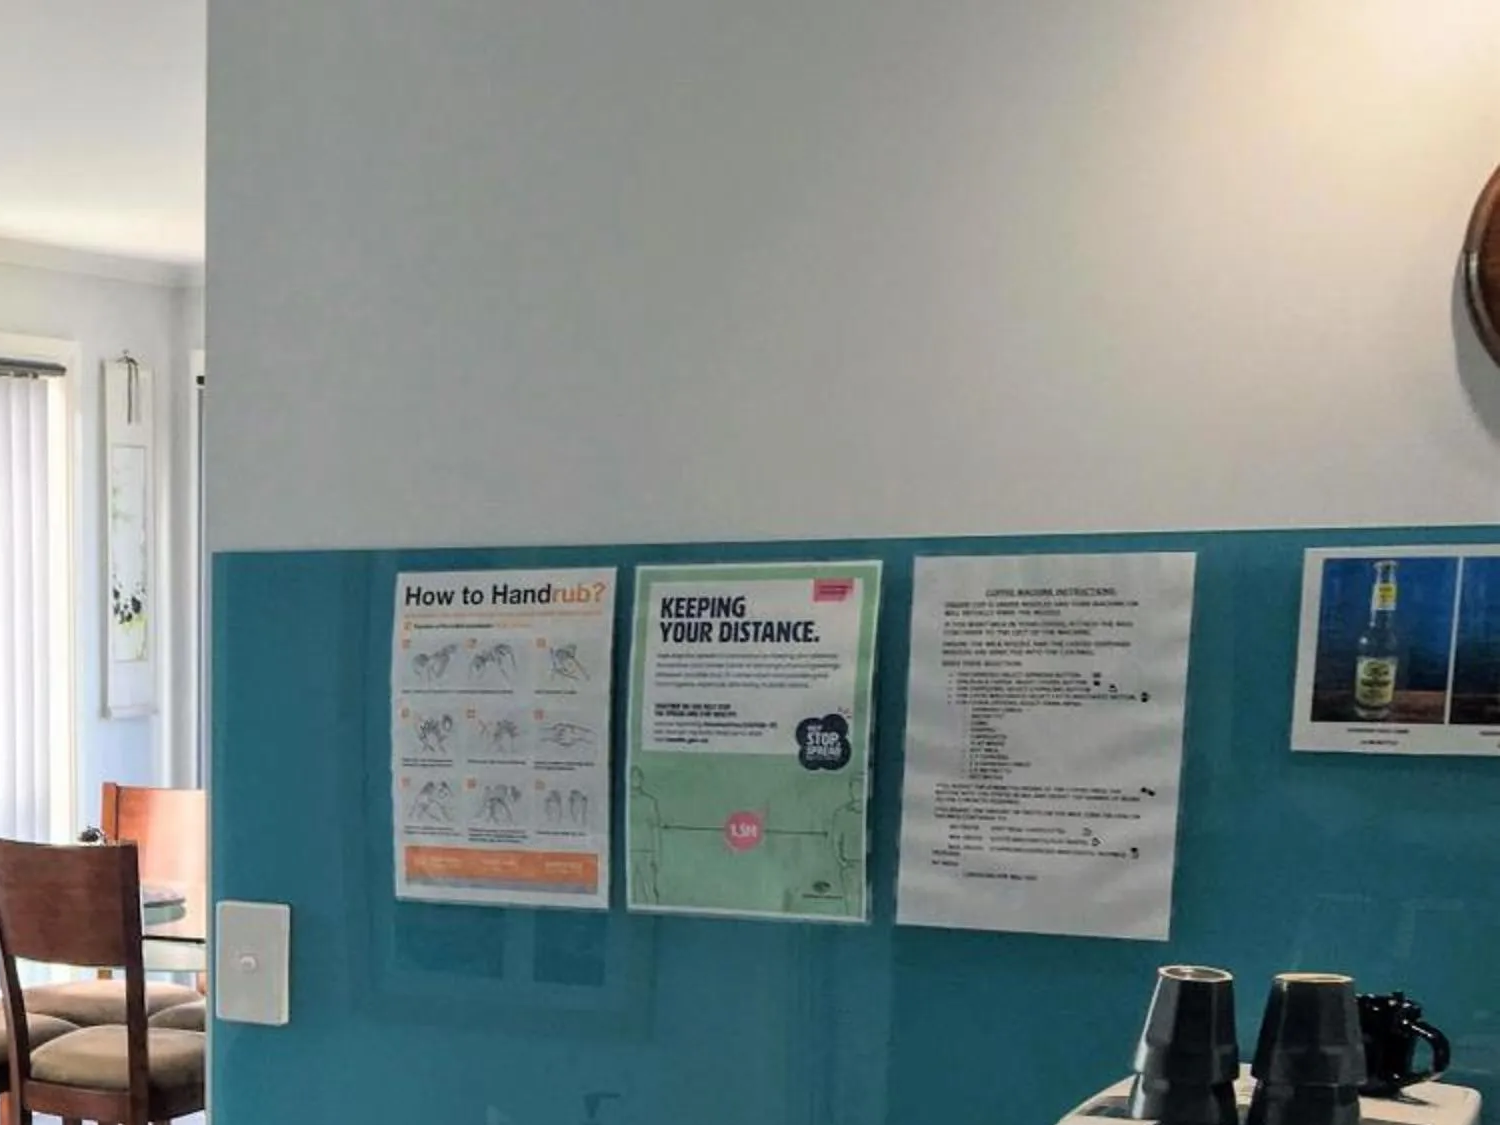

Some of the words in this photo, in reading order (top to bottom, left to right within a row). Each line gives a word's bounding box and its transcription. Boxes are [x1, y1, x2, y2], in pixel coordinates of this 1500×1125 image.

[405, 585, 455, 606] How
[462, 586, 485, 605] to
[491, 582, 606, 605] Handrub?
[660, 596, 746, 619] KEEPING
[659, 621, 713, 643] YOUR
[718, 620, 821, 643] DISTANCE.
